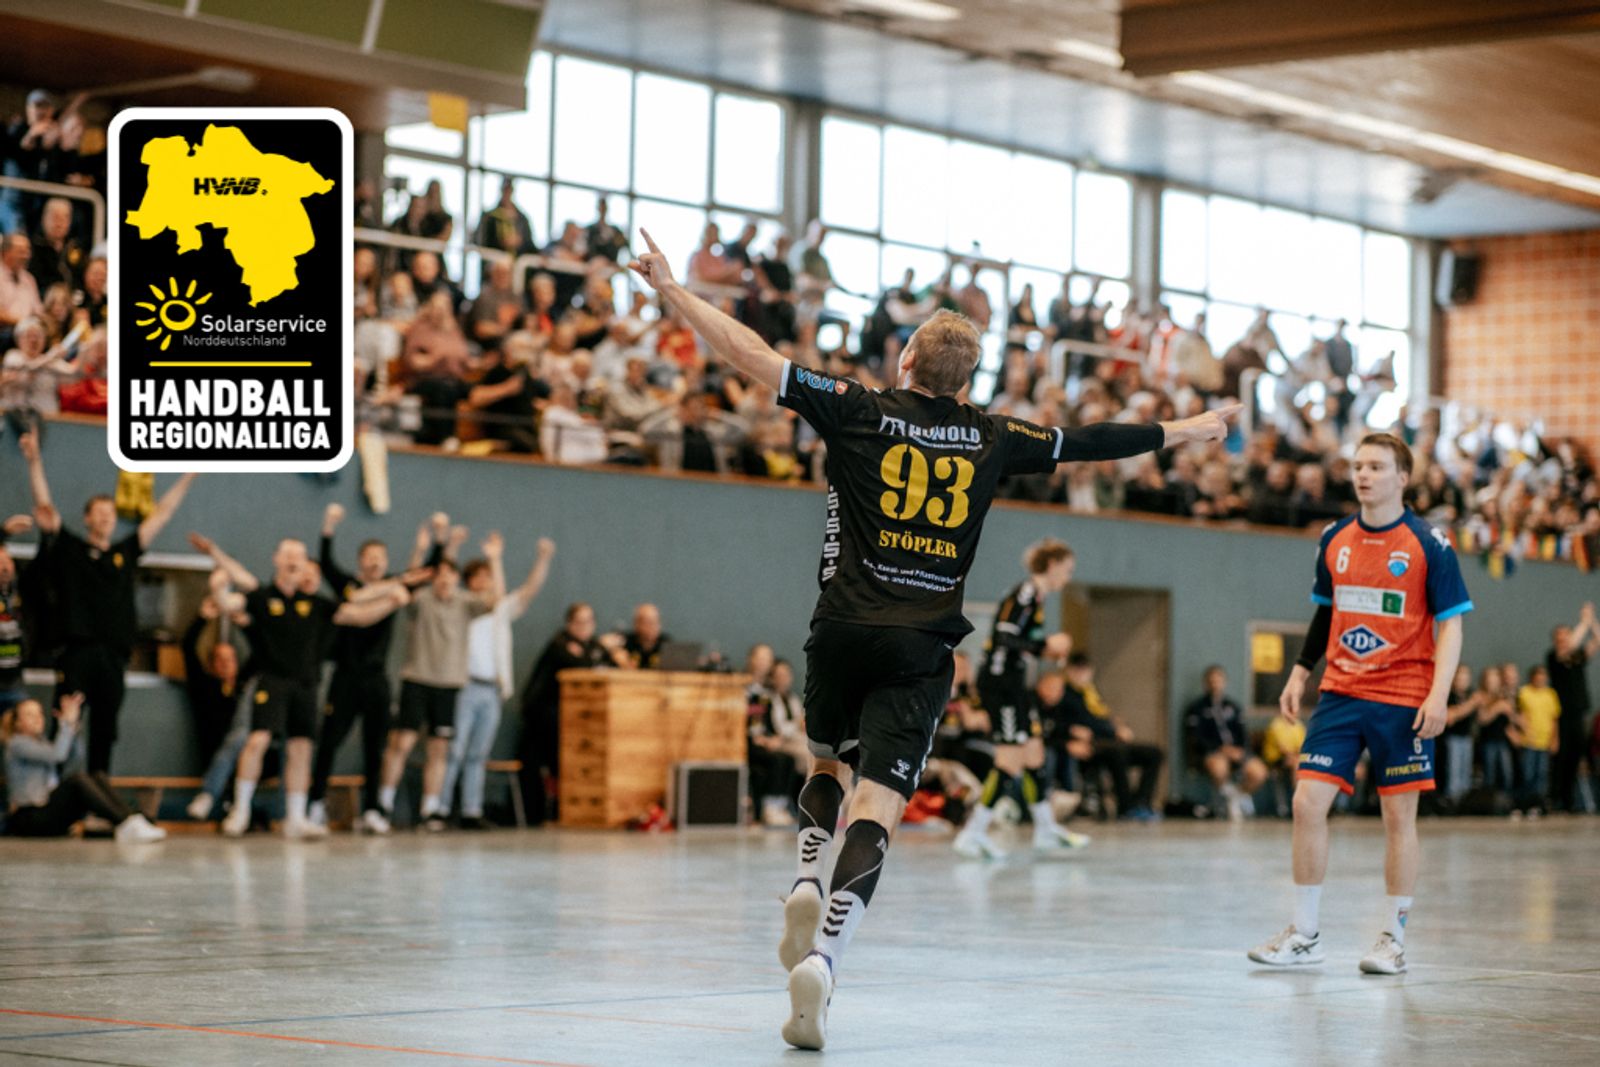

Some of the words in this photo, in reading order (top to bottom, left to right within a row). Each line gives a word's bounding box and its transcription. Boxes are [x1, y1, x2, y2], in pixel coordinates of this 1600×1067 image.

[880, 443, 975, 528] 93
[879, 529, 958, 560] STÖPLER
[1336, 545, 1352, 574] 6
[1346, 631, 1377, 650] TDS
